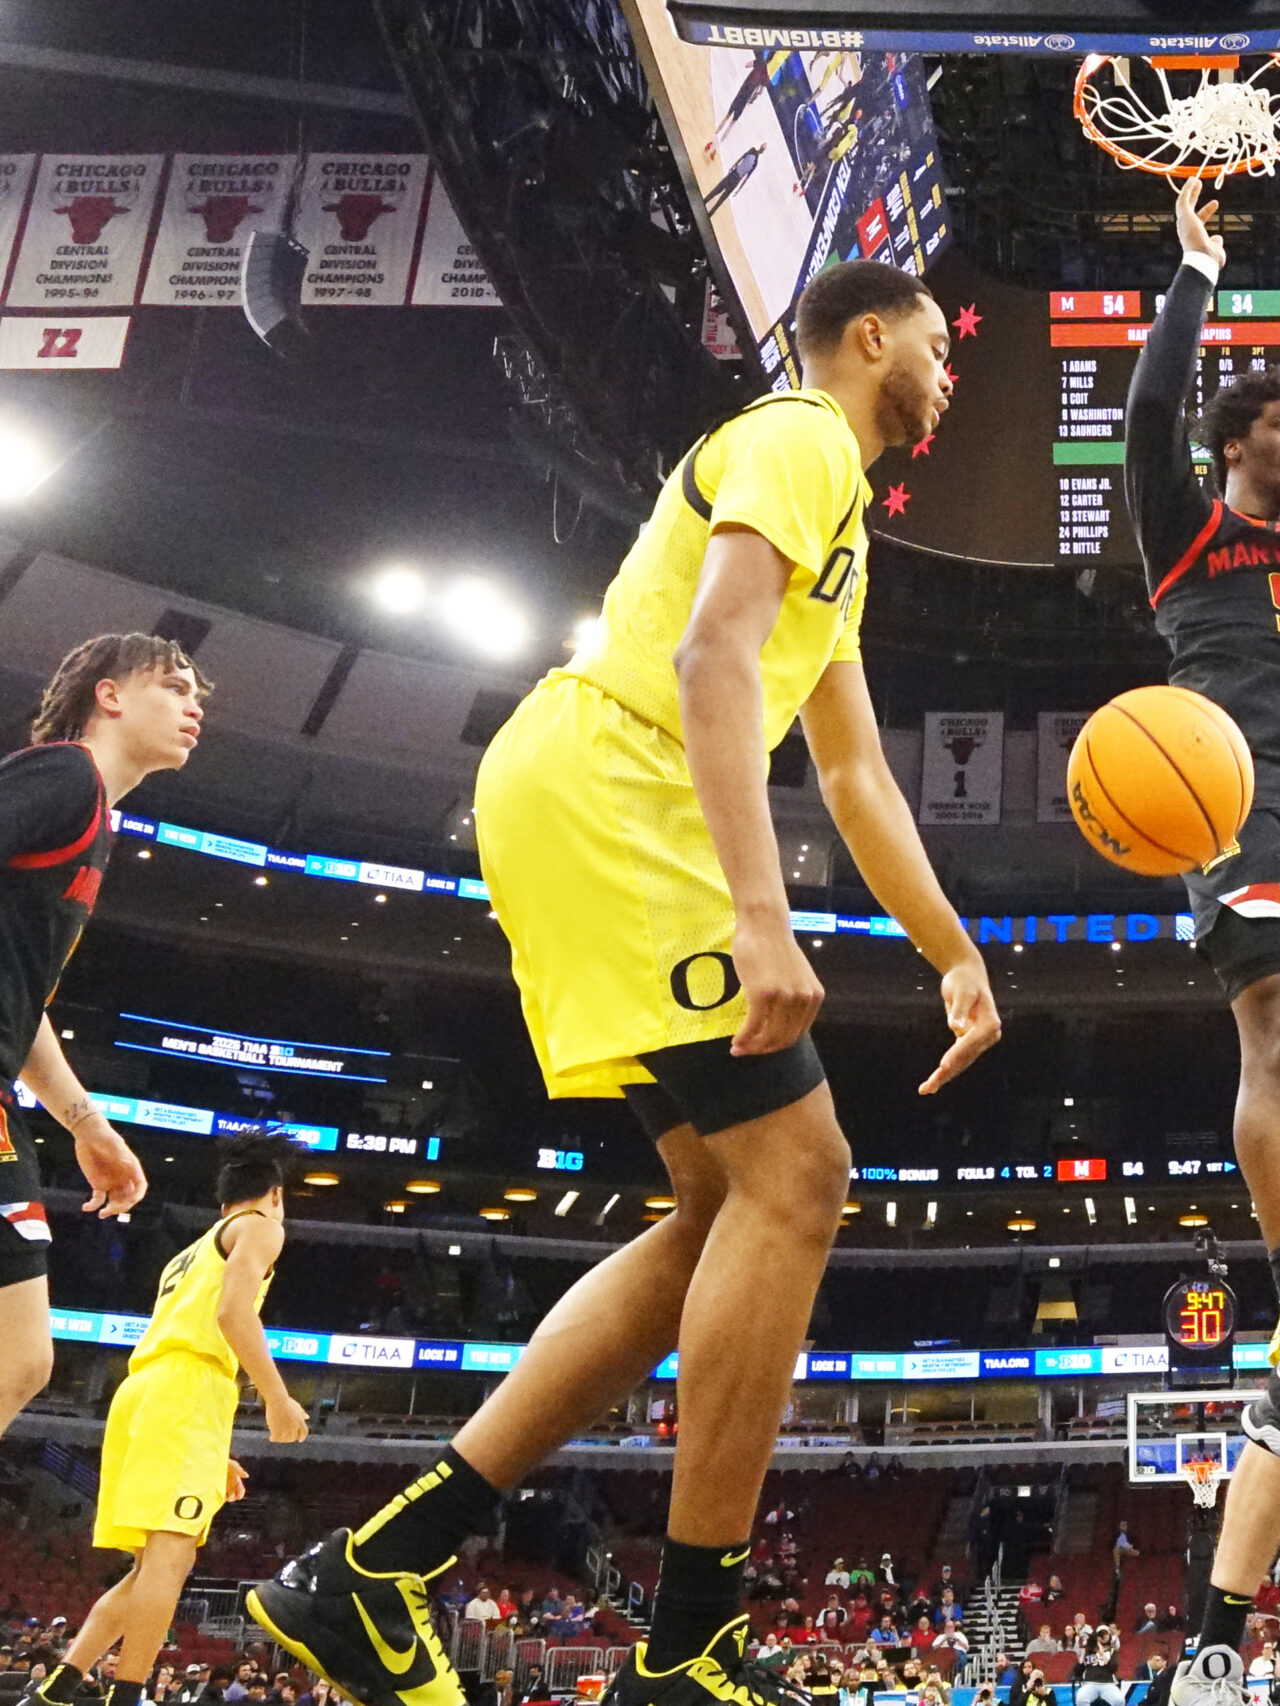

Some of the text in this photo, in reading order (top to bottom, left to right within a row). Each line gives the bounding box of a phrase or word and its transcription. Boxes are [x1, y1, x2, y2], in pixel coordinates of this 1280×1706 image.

[974, 34, 1044, 48] Allstate
[1150, 35, 1218, 49] Allstate
[55, 163, 147, 178] CHICAGO
[187, 162, 279, 176] CHICAGO
[321, 162, 411, 176] CHICAGO
[66, 180, 130, 193] BULLS
[199, 180, 266, 193] BULLS
[334, 179, 396, 192] BULLS
[56, 245, 109, 256] CENTRAL
[187, 247, 241, 257] CENTRAL
[324, 245, 377, 255] CENTRAL
[50, 260, 109, 270] DIVISION
[182, 261, 240, 271] DIVISION
[319, 259, 376, 270] DIVISION
[36, 273, 113, 285] CHAMPIONS
[169, 275, 241, 286] CHAMPION
[307, 273, 385, 284] CHAMPIONS
[174, 289, 236, 300] 1996-97
[1061, 296, 1074, 312] M
[1103, 295, 1125, 315] 54
[1232, 294, 1253, 315] 34
[1069, 361, 1097, 372] ADAMS
[1062, 377, 1068, 388] 7
[1069, 376, 1094, 388] MILLS
[1070, 393, 1089, 404] COIT
[1070, 408, 1124, 421] WASHINGTON
[1058, 425, 1112, 437] 13 SAUNDERS
[1071, 479, 1097, 491] EVANS
[1060, 495, 1103, 506] 12 CARTER
[1060, 511, 1110, 522] 13 STEWART
[1059, 526, 1108, 538] 24 PHILLIPS
[1072, 542, 1101, 554] BITTLE
[954, 770, 967, 798] 1
[383, 870, 414, 885] TIAA
[960, 913, 1159, 944] NITED
[670, 951, 741, 1011] O
[242, 1040, 268, 1055] TIAA
[162, 1037, 344, 1073] MEN'S BASKETBALL TOURNAMENT
[389, 1136, 417, 1155] PM
[861, 1168, 897, 1181] 100%
[899, 1168, 938, 1182] BONUS
[957, 1167, 995, 1180] FOULS
[1001, 1167, 1010, 1179] 4
[1043, 1165, 1052, 1178] 2
[1074, 1161, 1090, 1178] M
[1122, 1162, 1144, 1176] 54
[1168, 1160, 1201, 1175] 9:47
[1187, 1291, 1224, 1310] 9:47
[1180, 1311, 1221, 1343] 30
[361, 1344, 402, 1361] TIAA
[419, 1349, 457, 1362] LOCK IN
[811, 1359, 846, 1372] LOCK IN
[984, 1357, 1029, 1370] TIAA.ORG
[1132, 1353, 1168, 1367] TIAA
[174, 1495, 203, 1520] O
